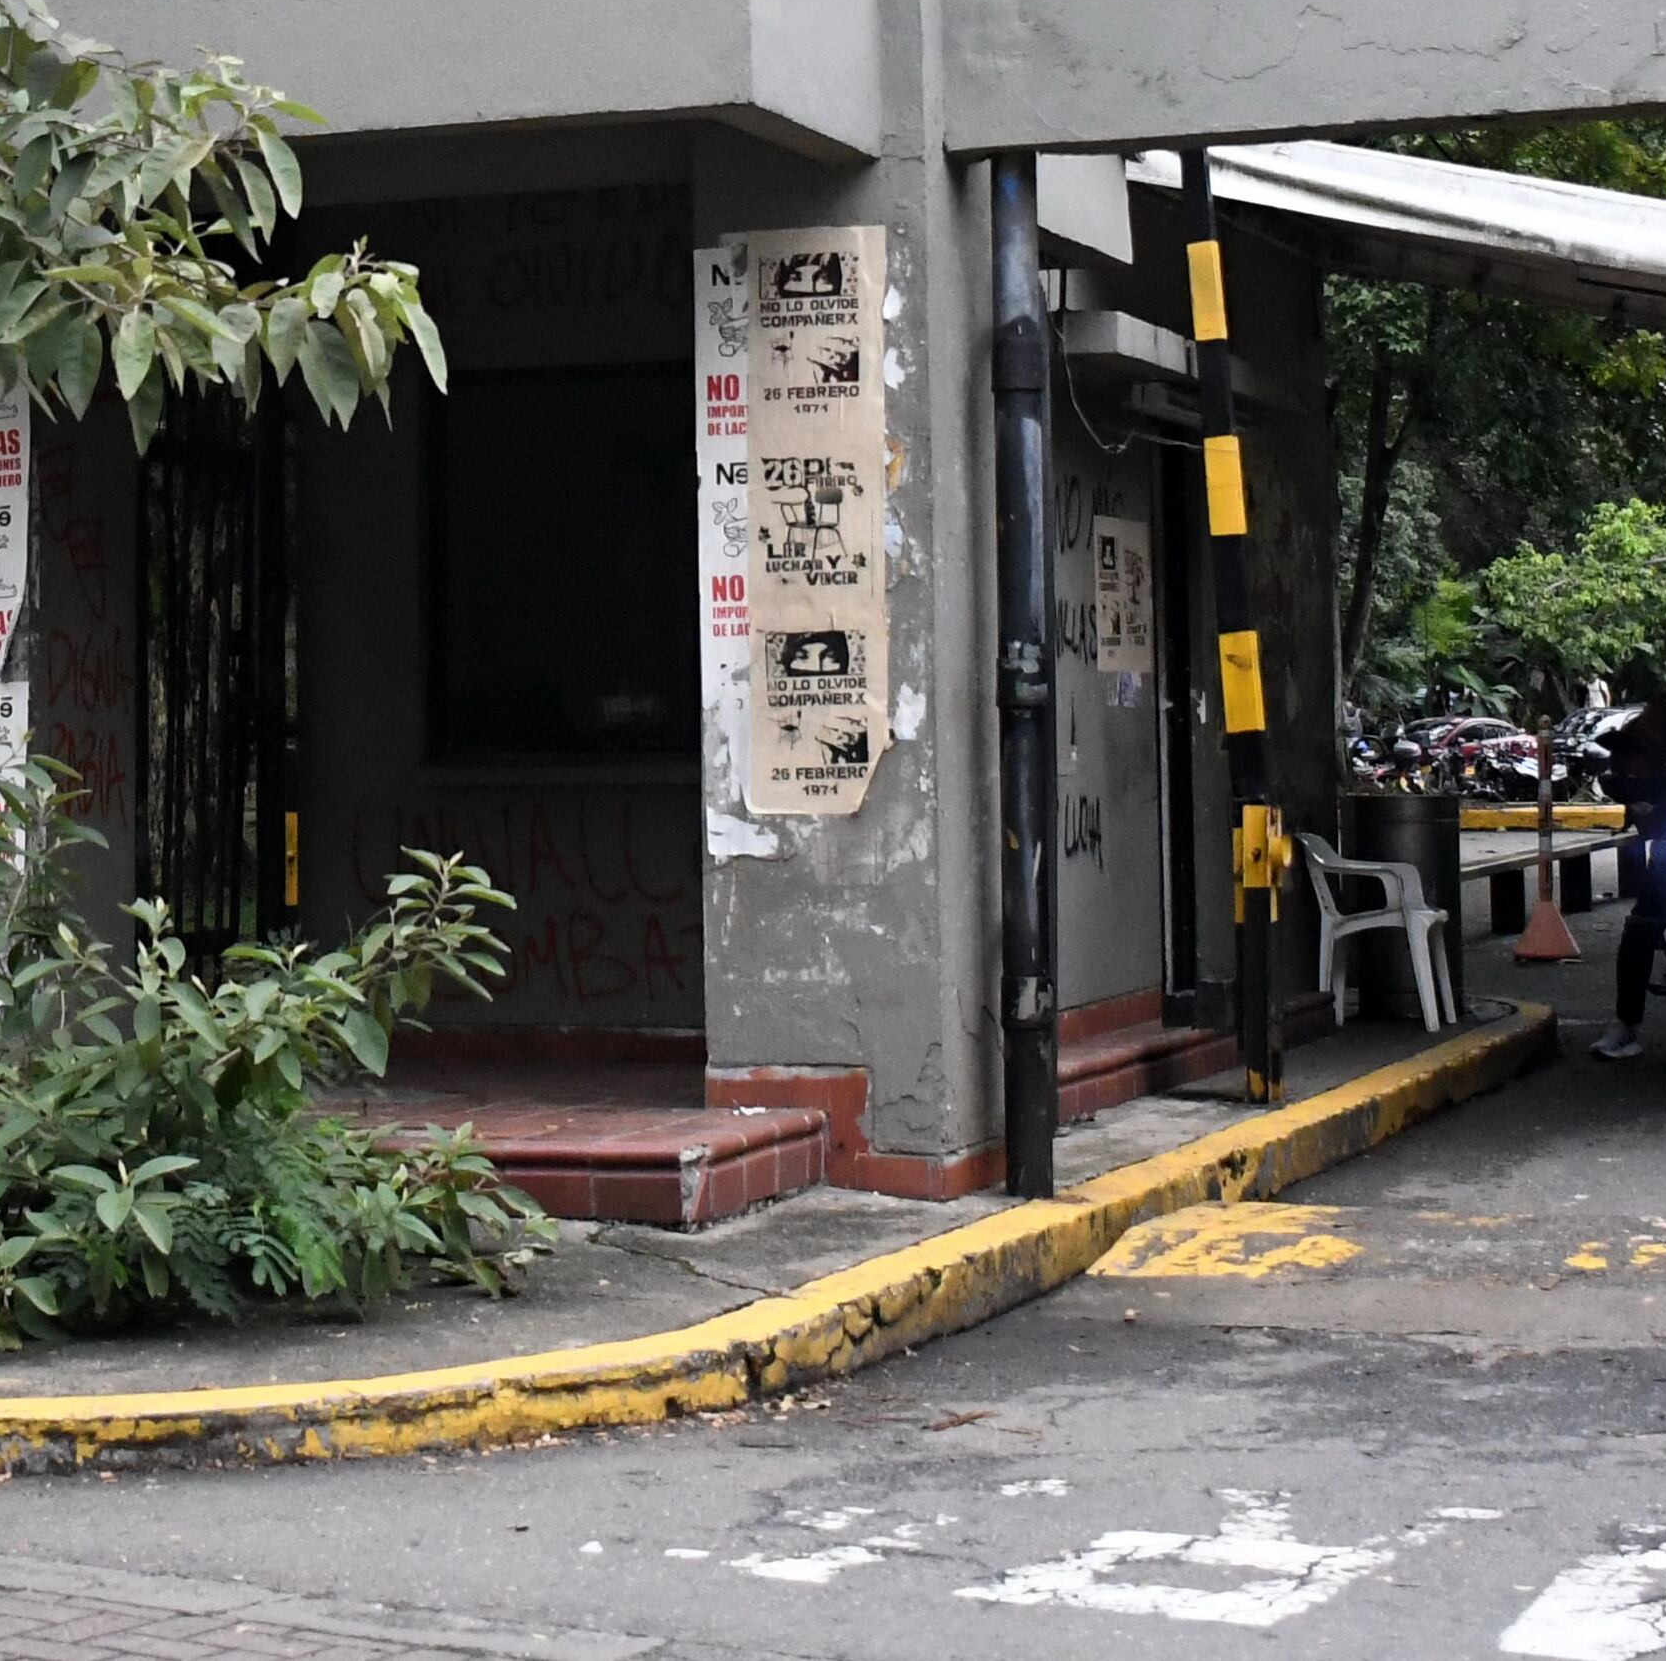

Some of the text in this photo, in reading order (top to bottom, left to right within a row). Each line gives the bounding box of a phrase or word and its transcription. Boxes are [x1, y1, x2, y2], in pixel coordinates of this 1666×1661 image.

[760, 298, 859, 314] NO LO OLVIDE
[707, 374, 740, 401] NO
[764, 385, 859, 401] 26 FEBRERO
[793, 403, 829, 414] 1971
[708, 423, 721, 436] DE
[761, 457, 803, 490] 26
[712, 574, 745, 602] NO
[712, 624, 727, 637] DE
[793, 679, 810, 691] LO
[817, 677, 867, 689] OLVIDE
[771, 766, 868, 780] 26 FEBRERO
[803, 784, 838, 796] 1971
